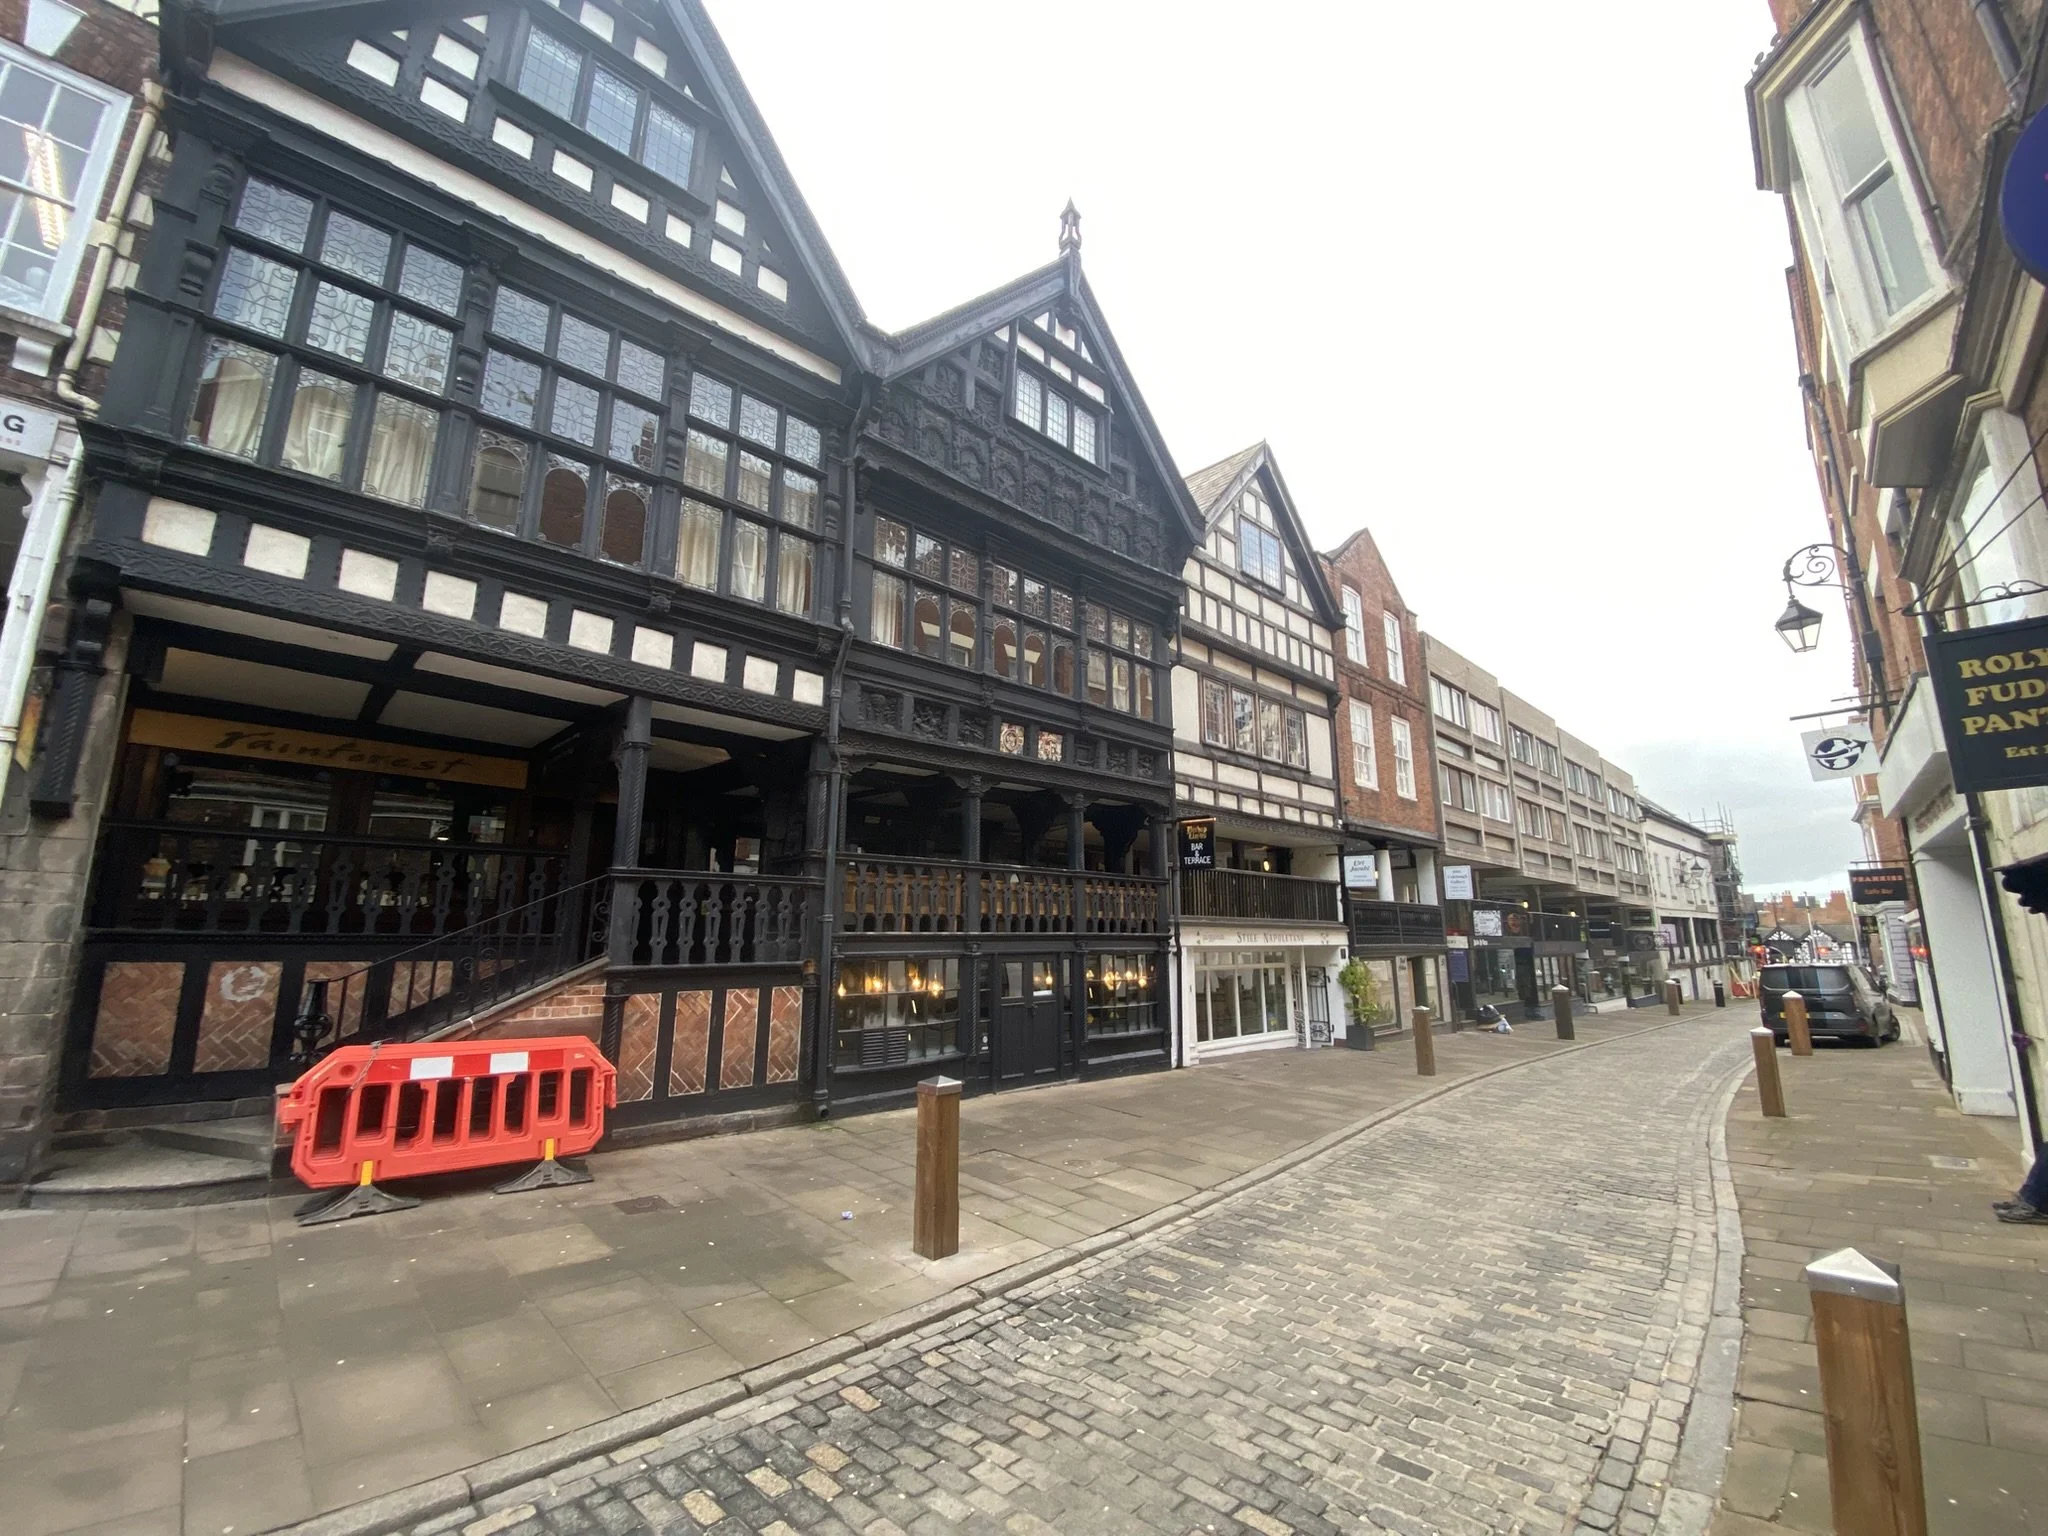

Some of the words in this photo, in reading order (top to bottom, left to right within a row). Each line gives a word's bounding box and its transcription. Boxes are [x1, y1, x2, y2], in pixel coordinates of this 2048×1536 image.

[1965, 678, 2048, 707] FUD
[2004, 746, 2039, 758] Est
[1190, 842, 1204, 851] BAR
[1184, 856, 1212, 865] TERRACE
